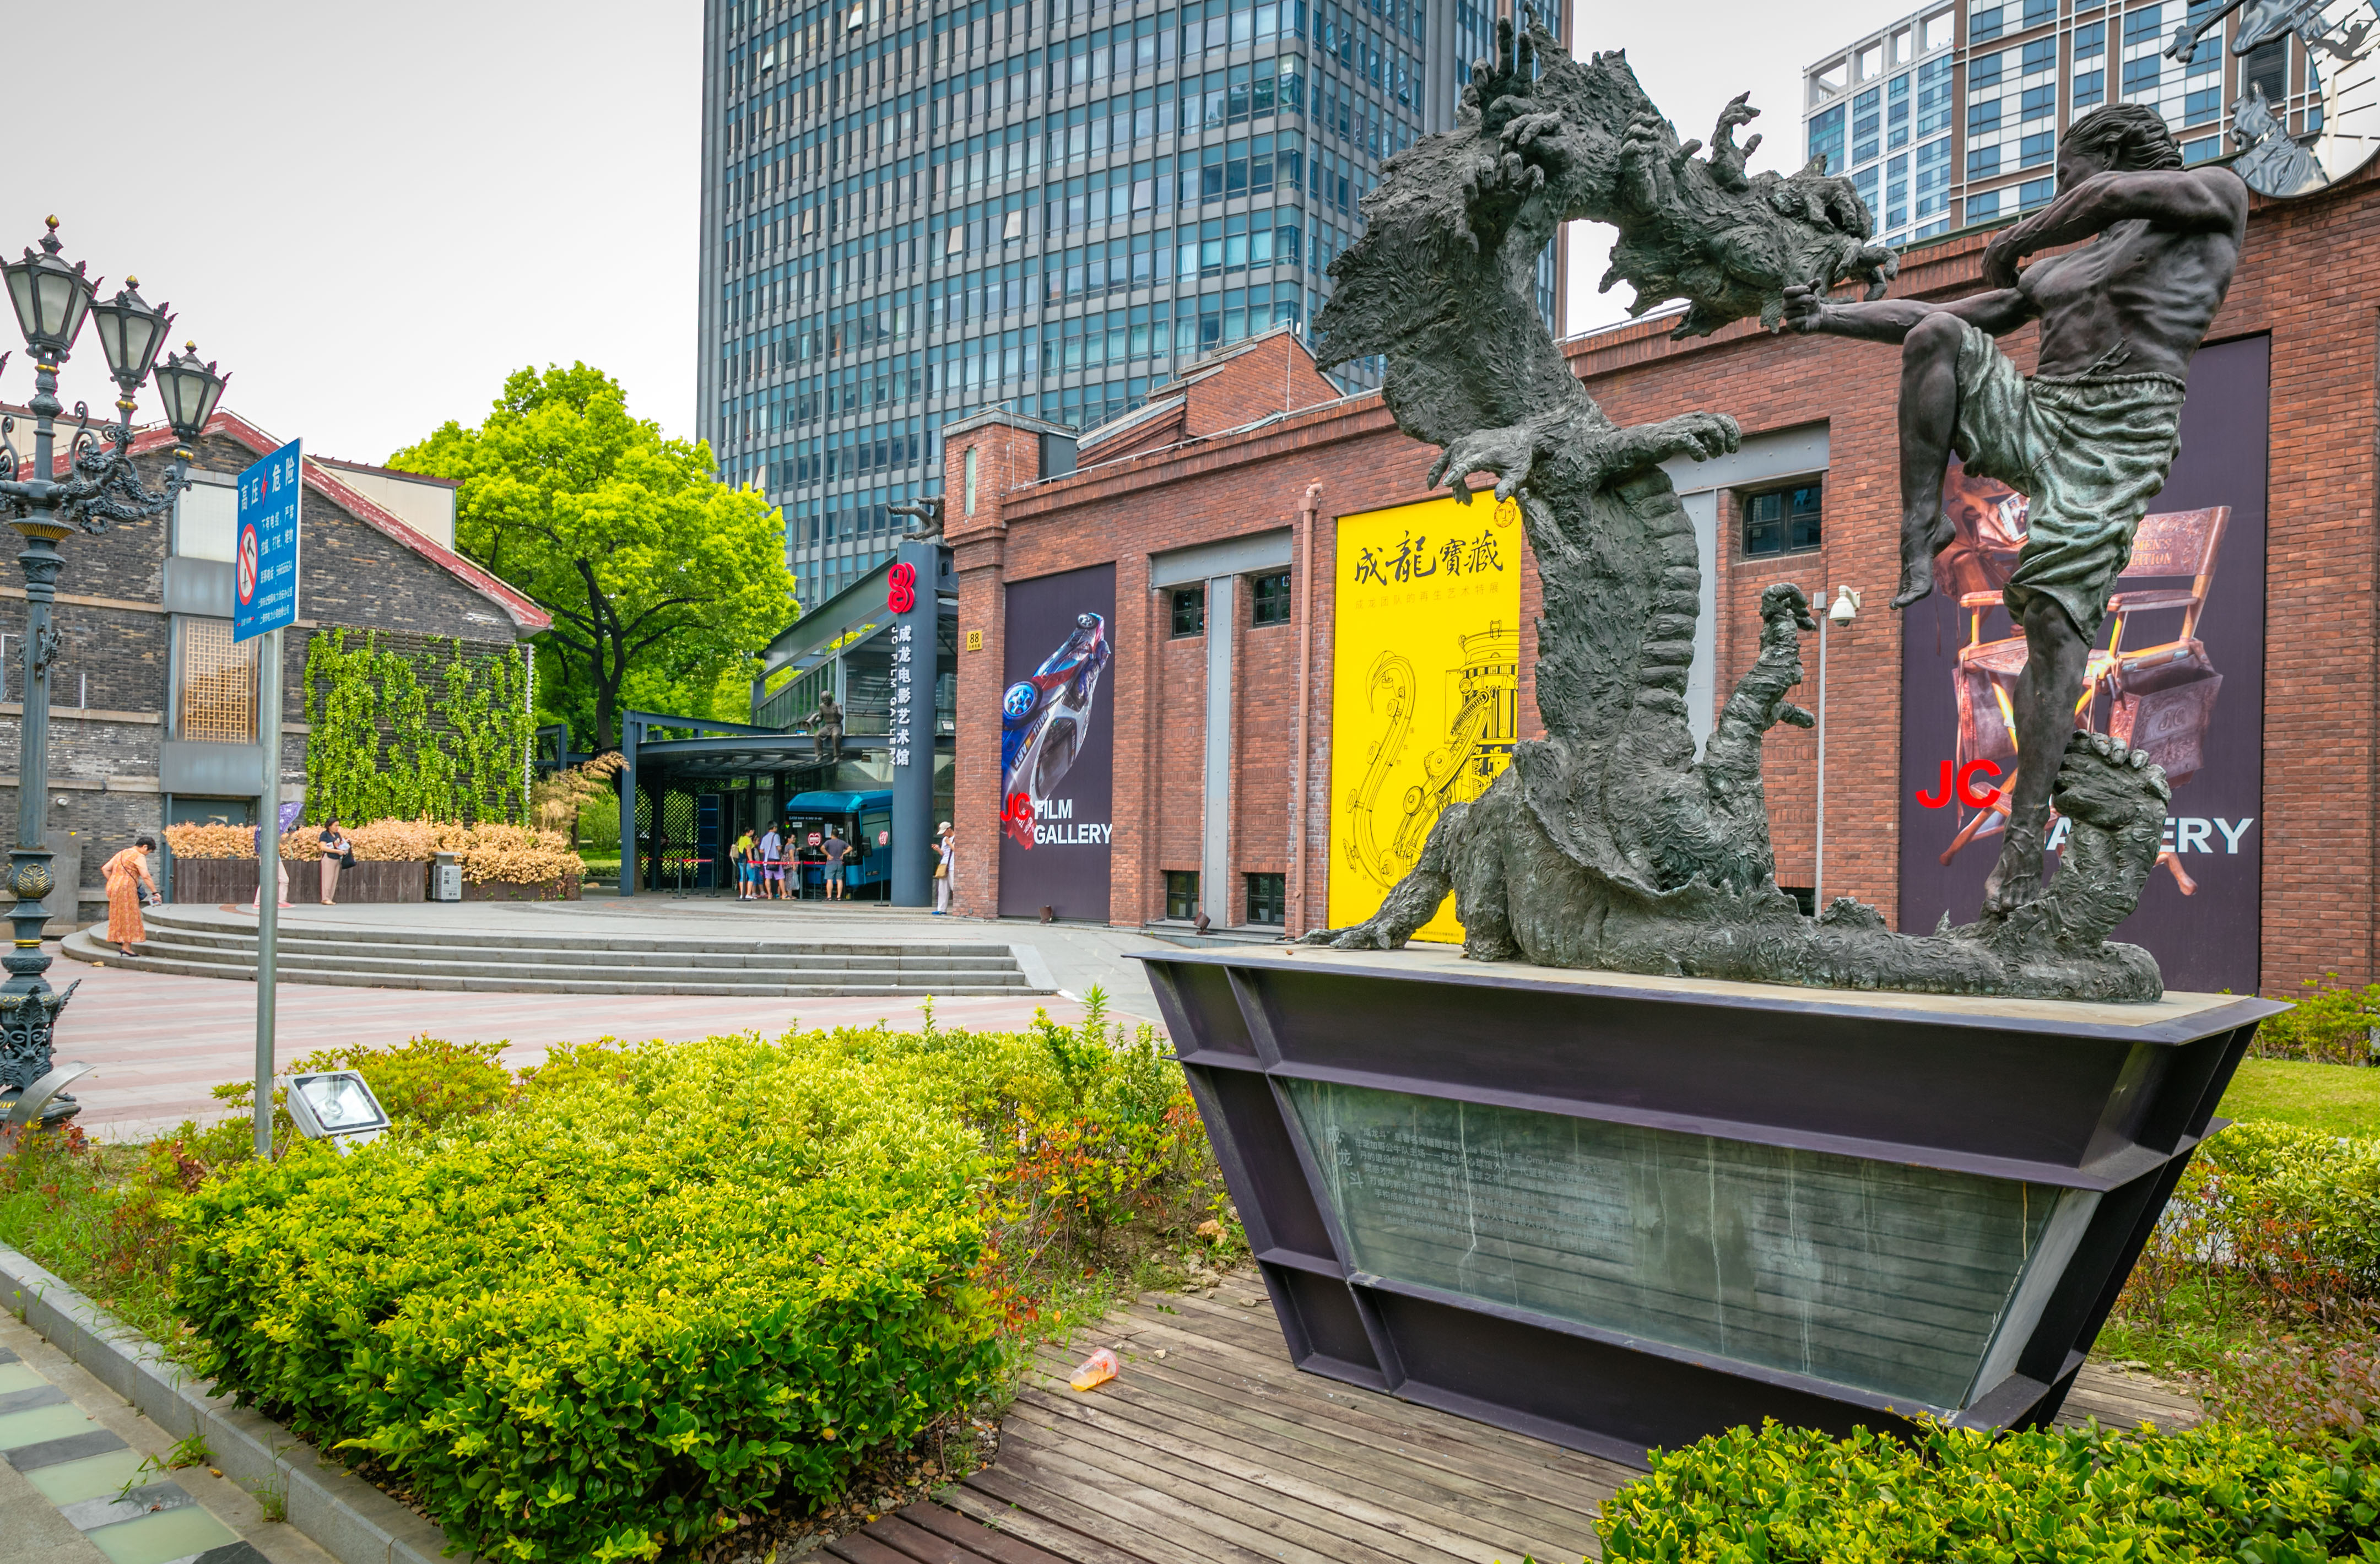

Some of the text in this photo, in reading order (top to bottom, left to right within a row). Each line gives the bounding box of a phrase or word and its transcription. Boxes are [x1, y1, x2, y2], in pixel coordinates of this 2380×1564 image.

[1355, 581, 1499, 610] 成龙团队的再生艺术特展
[970, 633, 979, 643] 88
[890, 653, 899, 689] FILM
[896, 625, 912, 767] 成龙电影艺术馆
[889, 696, 897, 766] GALLERY
[1915, 759, 2003, 809] JC
[1000, 792, 1073, 822] JC FILM
[1034, 823, 1113, 844] GALLERY
[2044, 817, 2254, 854] AERY
